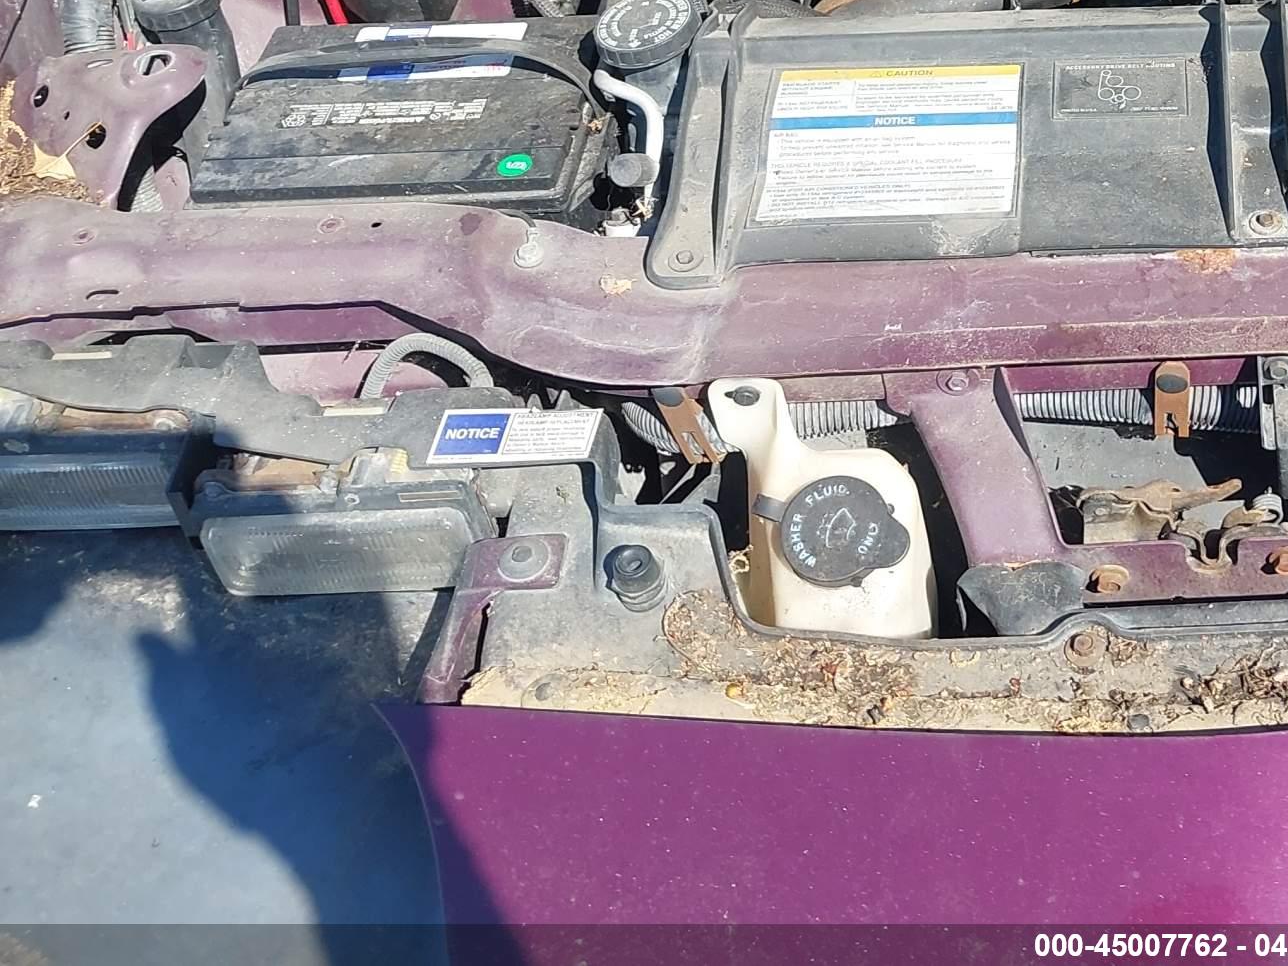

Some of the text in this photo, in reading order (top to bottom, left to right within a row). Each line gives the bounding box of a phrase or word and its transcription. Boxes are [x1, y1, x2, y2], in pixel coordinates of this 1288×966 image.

[885, 69, 934, 77] CAUTION
[874, 116, 917, 126] NOTICE
[445, 427, 501, 440] NOTICE
[790, 513, 817, 568] WASHER
